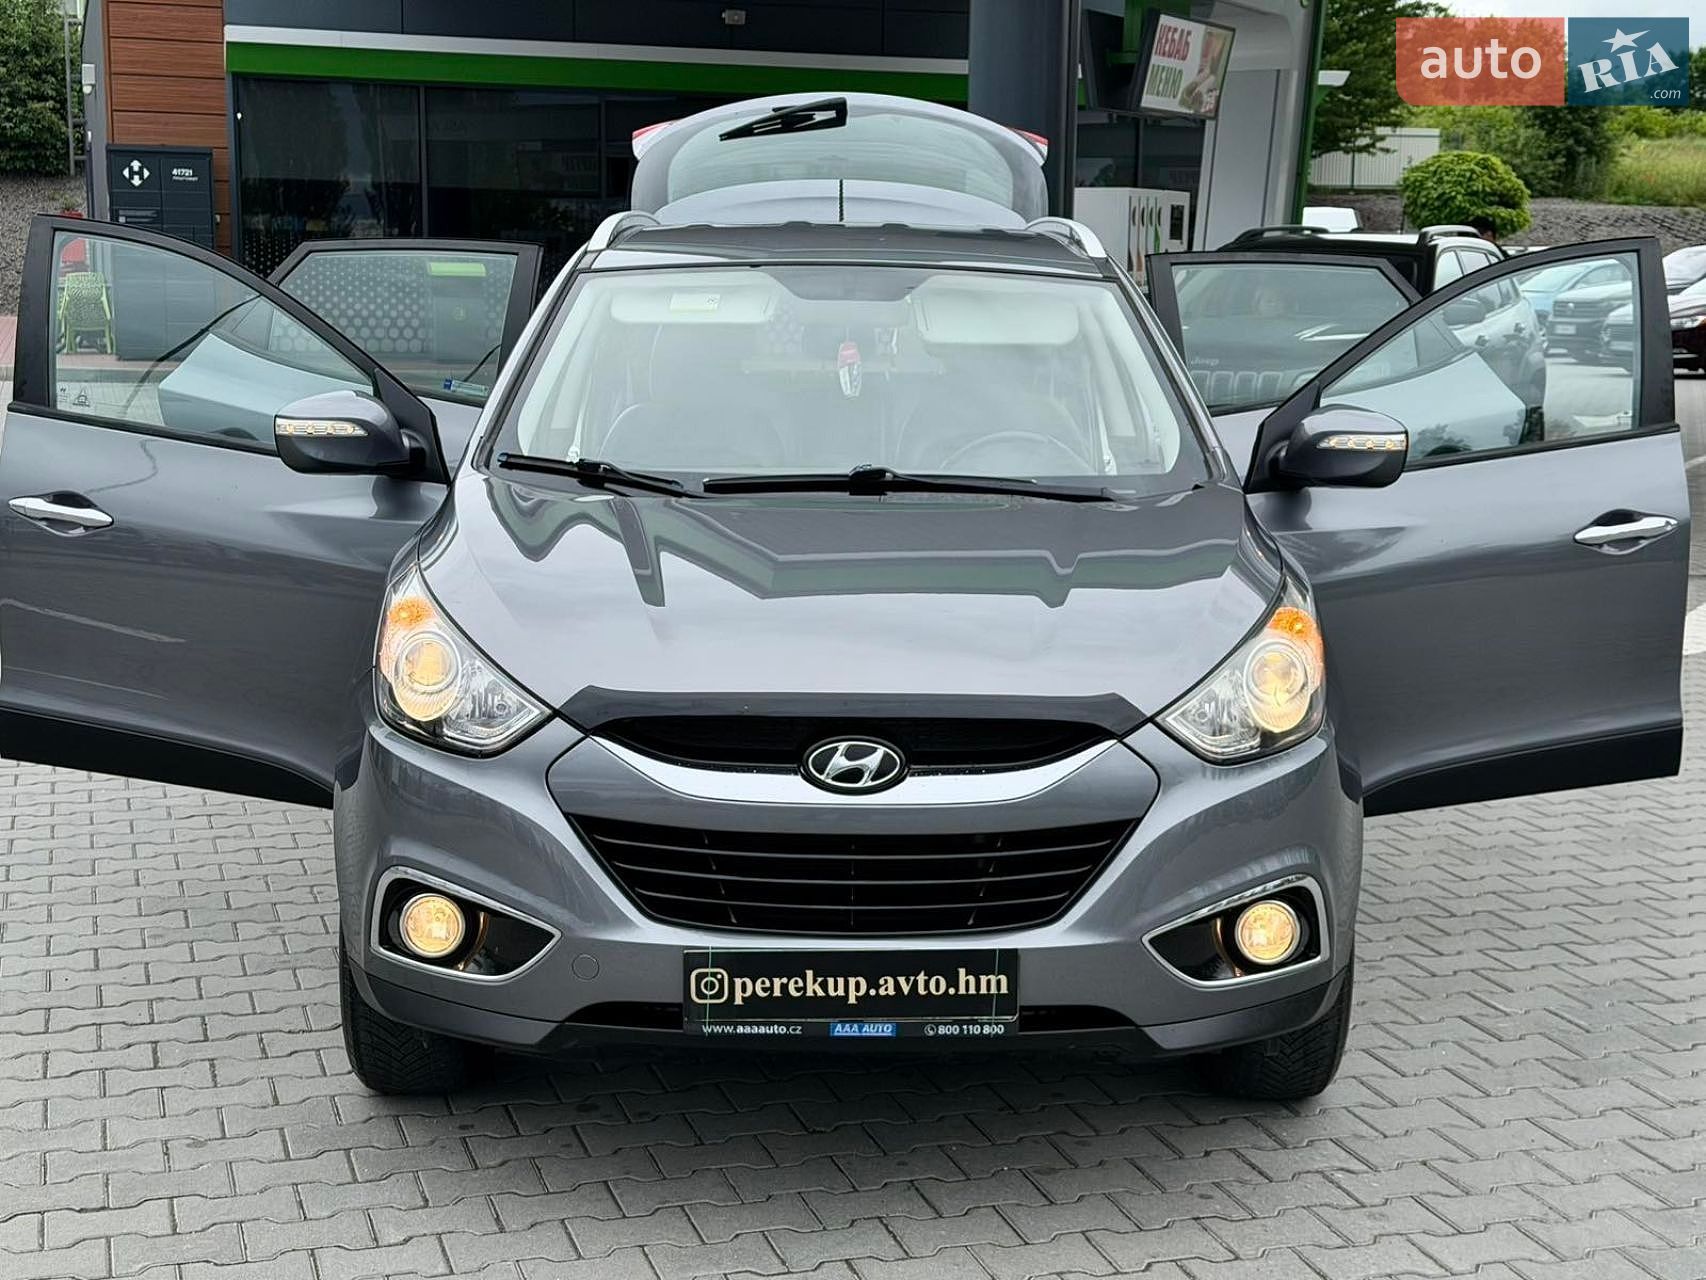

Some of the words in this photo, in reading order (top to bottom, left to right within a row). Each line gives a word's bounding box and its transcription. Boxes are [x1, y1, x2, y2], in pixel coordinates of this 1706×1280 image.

[1154, 23, 1193, 62] КЕБАБ
[1145, 63, 1185, 99] МЕНЮ
[733, 967, 1010, 1006] perekup.avto.hm
[701, 1022, 803, 1035] www.aaaauto.cz
[833, 1023, 860, 1036] AAA
[862, 1023, 894, 1036] AUTO
[937, 1023, 960, 1035] 800
[962, 1023, 981, 1035] 110
[982, 1023, 1005, 1035] 800
